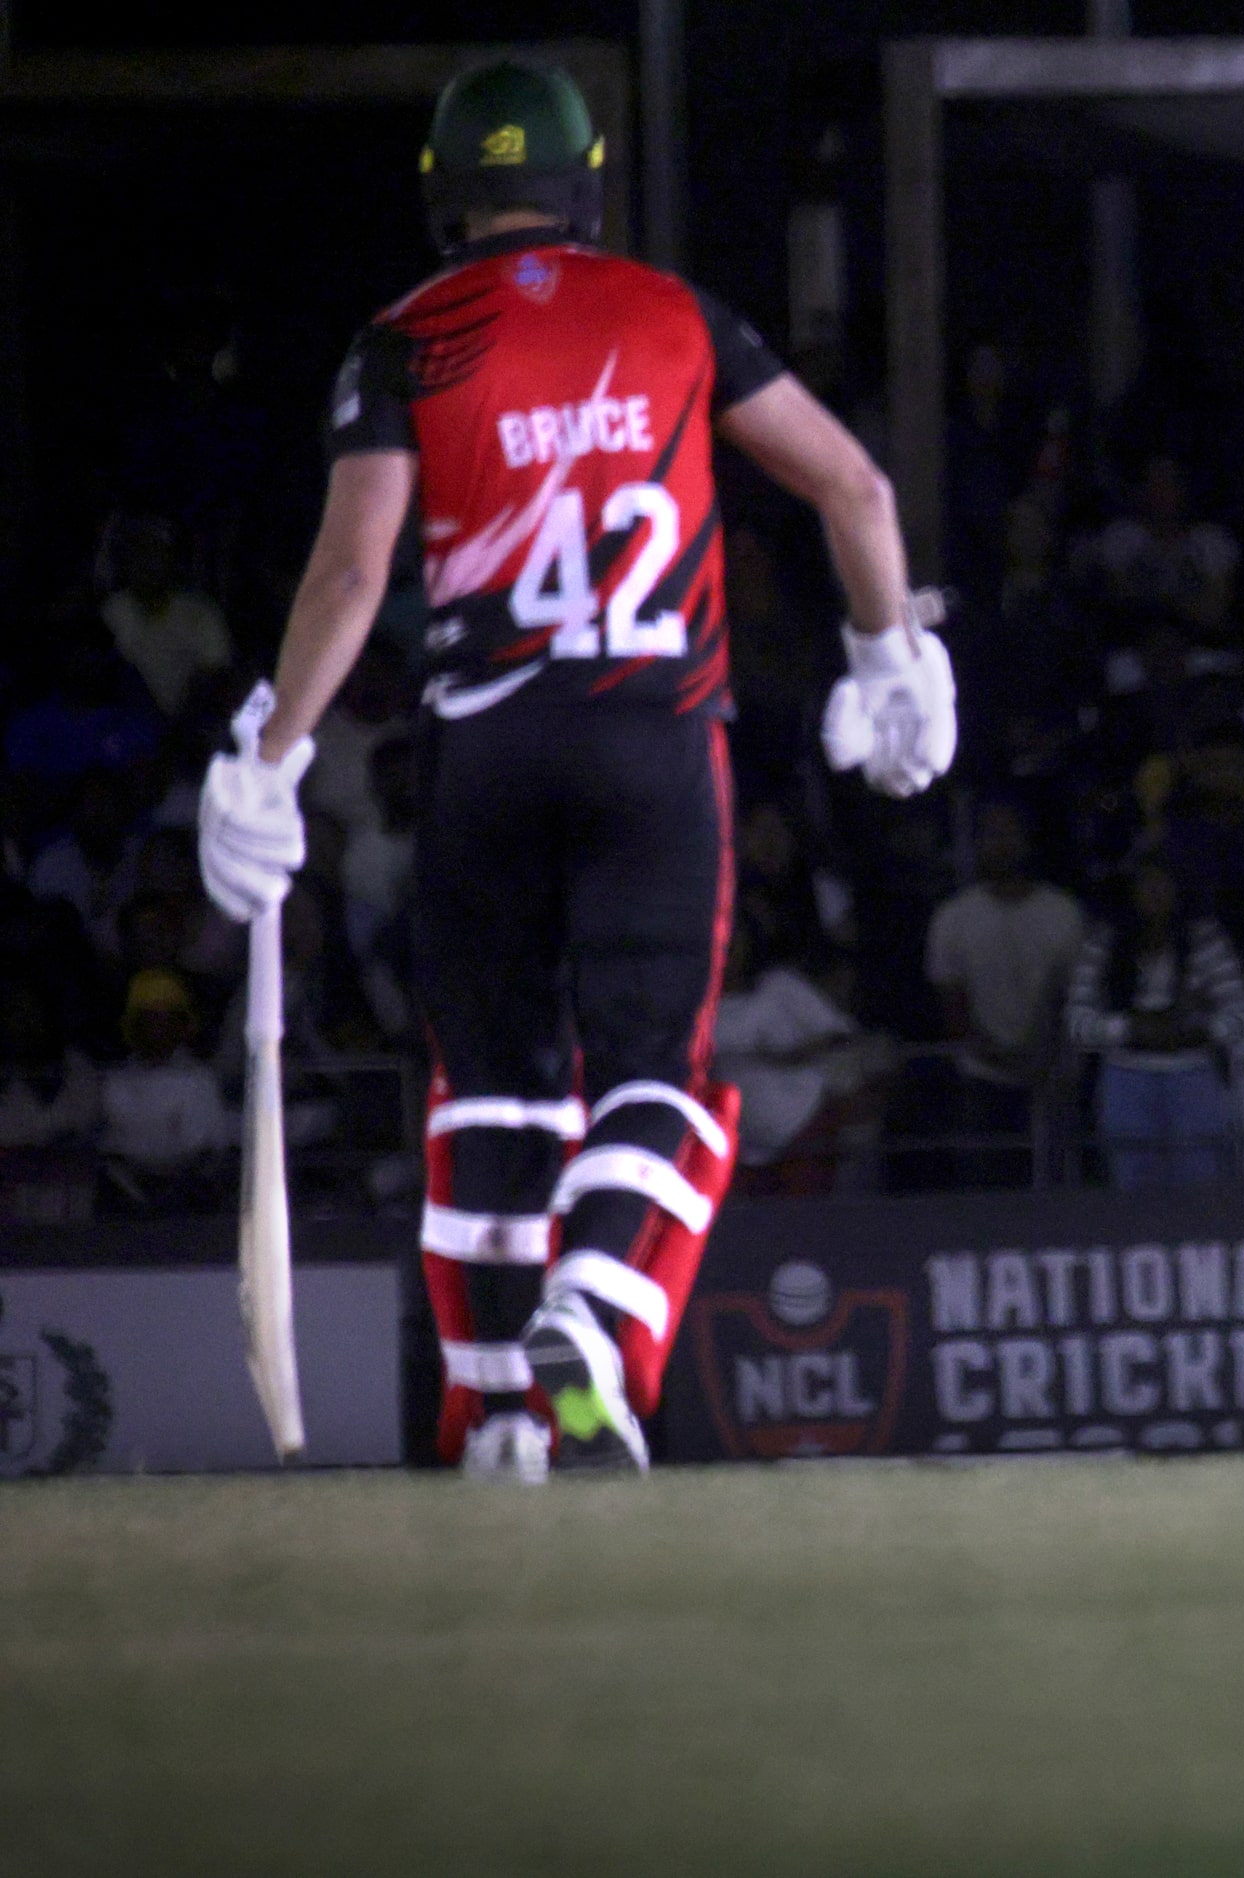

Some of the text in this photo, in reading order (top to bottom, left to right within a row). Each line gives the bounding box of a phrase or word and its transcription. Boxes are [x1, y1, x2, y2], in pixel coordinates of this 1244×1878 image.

[497, 394, 654, 468] BRUCE
[510, 482, 689, 660] 42
[733, 1349, 873, 1424] NCL
